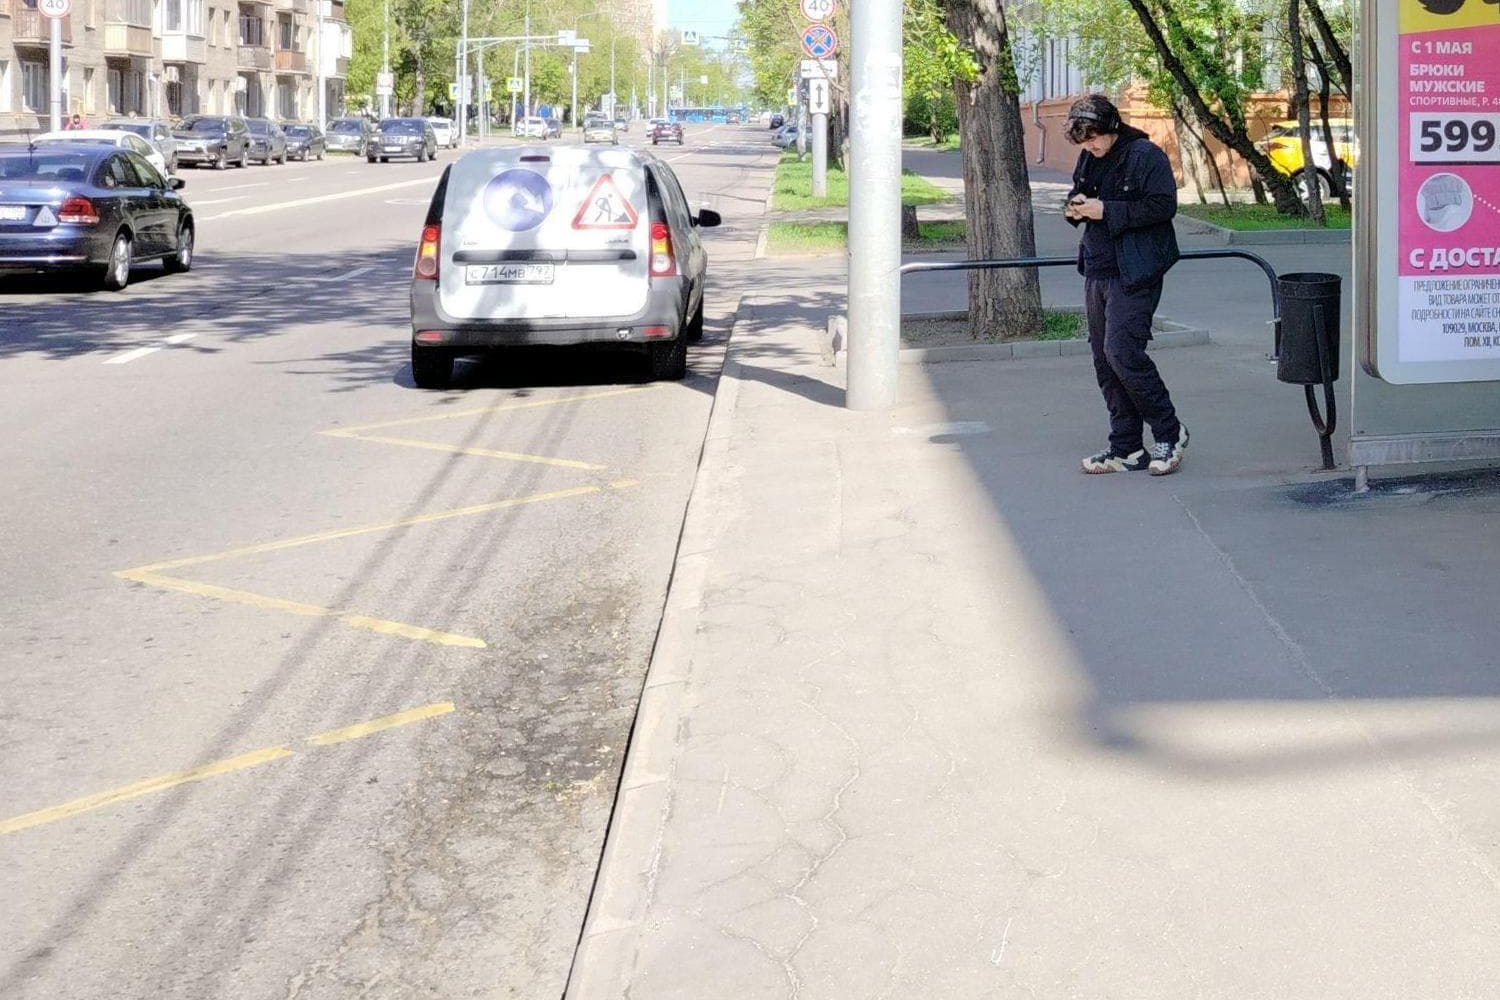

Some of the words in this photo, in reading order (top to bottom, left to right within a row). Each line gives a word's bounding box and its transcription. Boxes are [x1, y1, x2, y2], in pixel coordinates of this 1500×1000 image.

[46, 0, 65, 9] 40
[808, 0, 829, 11] 40
[1411, 41, 1421, 53] С
[1425, 41, 1432, 53] 1
[1436, 42, 1472, 54] МАЯ
[1410, 64, 1464, 76] БРЮКИ
[1410, 81, 1485, 92] МУЖСКИЕ
[1409, 96, 1480, 107] СПОРТИВНЫЕ,
[1482, 97, 1490, 105] Р.
[1420, 120, 1495, 152] 599
[1409, 248, 1425, 267] С
